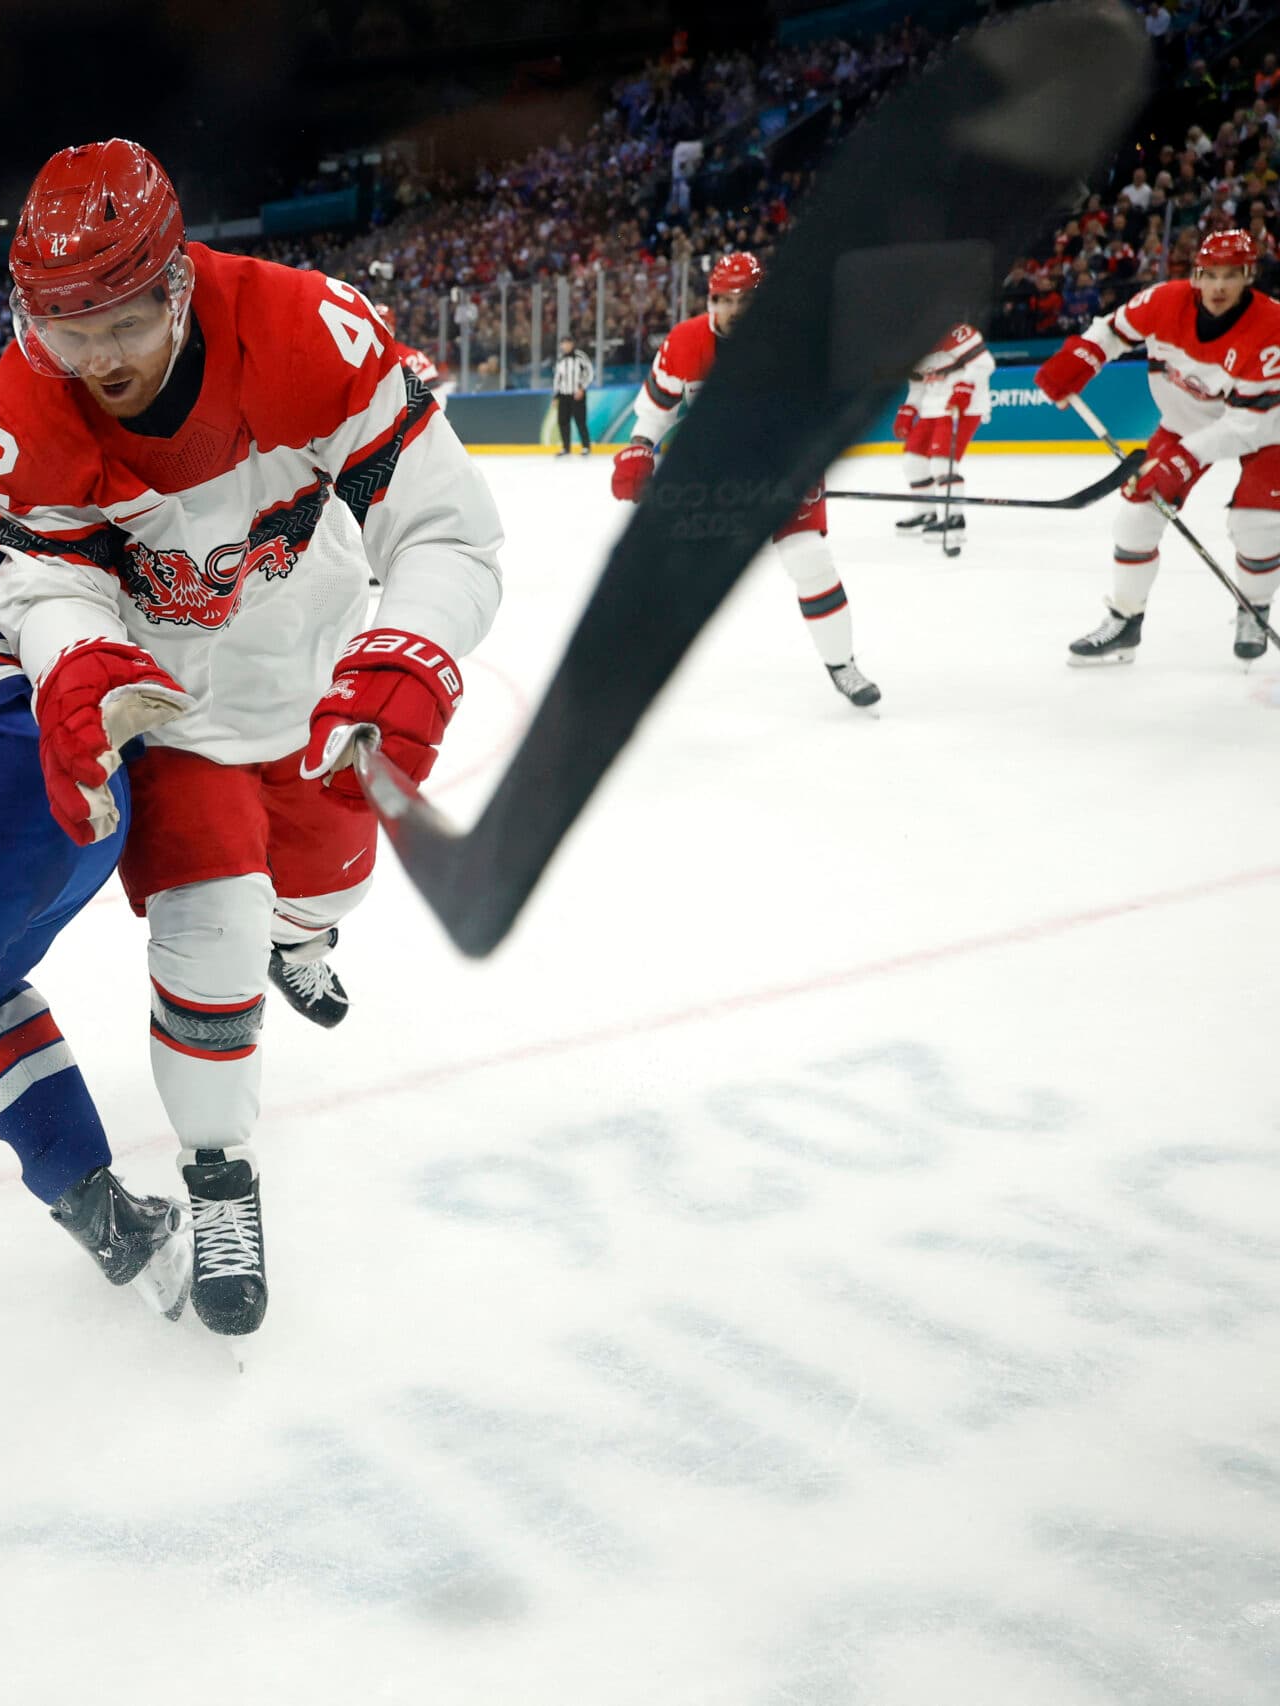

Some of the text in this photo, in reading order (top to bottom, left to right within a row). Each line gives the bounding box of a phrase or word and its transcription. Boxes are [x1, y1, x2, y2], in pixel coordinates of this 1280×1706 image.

[50, 236, 67, 257] 42
[40, 280, 91, 295] MILANO CORTINA
[318, 276, 395, 369] 42
